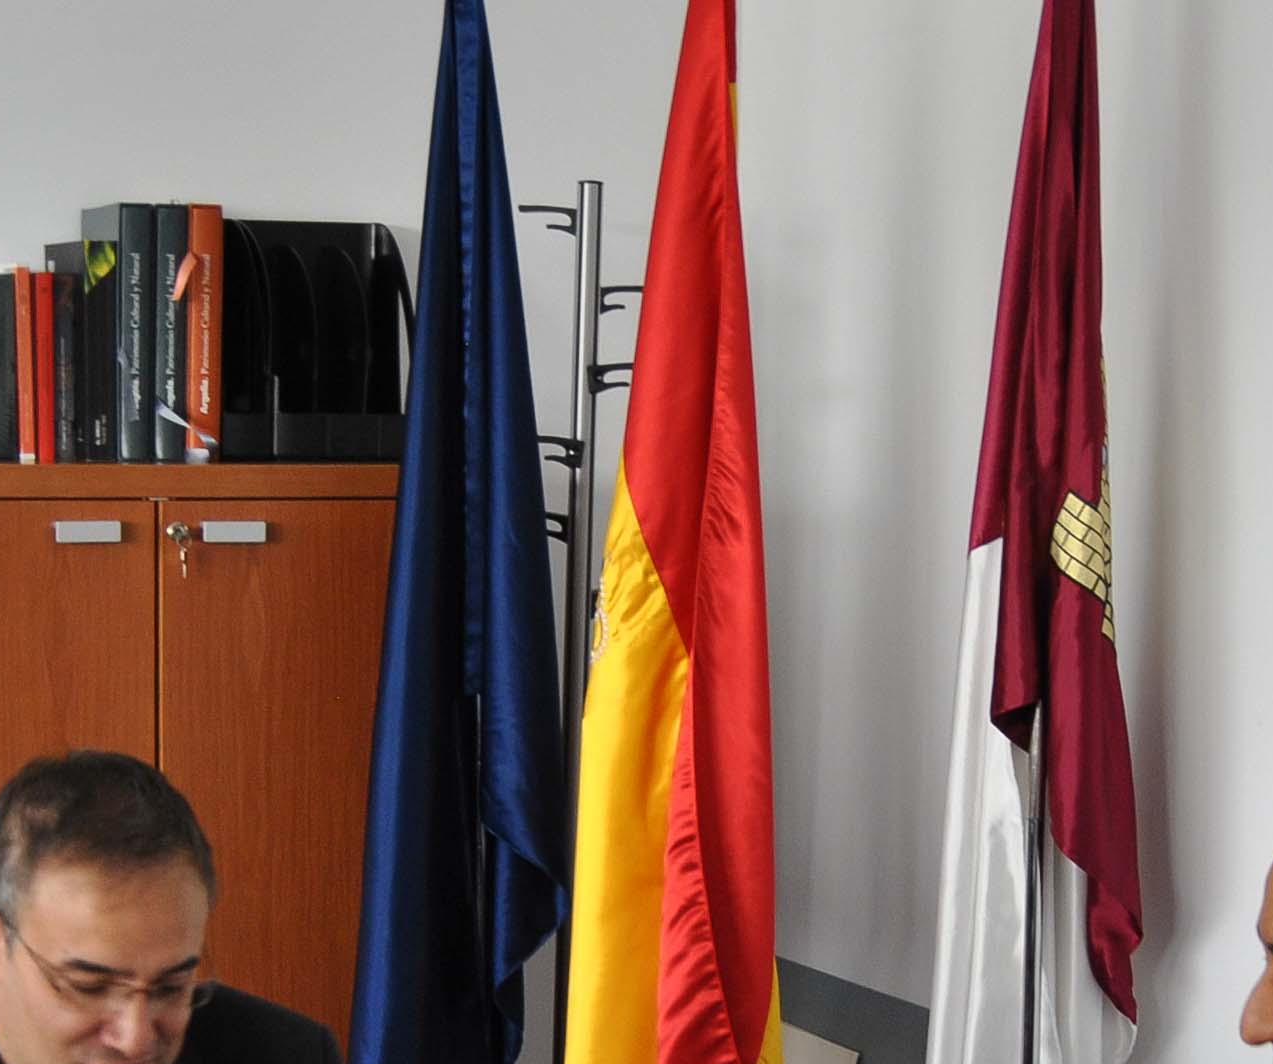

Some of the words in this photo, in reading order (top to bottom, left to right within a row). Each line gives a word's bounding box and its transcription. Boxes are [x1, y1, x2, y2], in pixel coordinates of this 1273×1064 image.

[130, 252, 140, 285] Natural
[129, 294, 140, 329] Cultural
[199, 294, 210, 329] Cultural
[130, 329, 141, 375] Patrimonio
[165, 329, 175, 375] Patrimonio
[200, 329, 210, 375] Patrimonio
